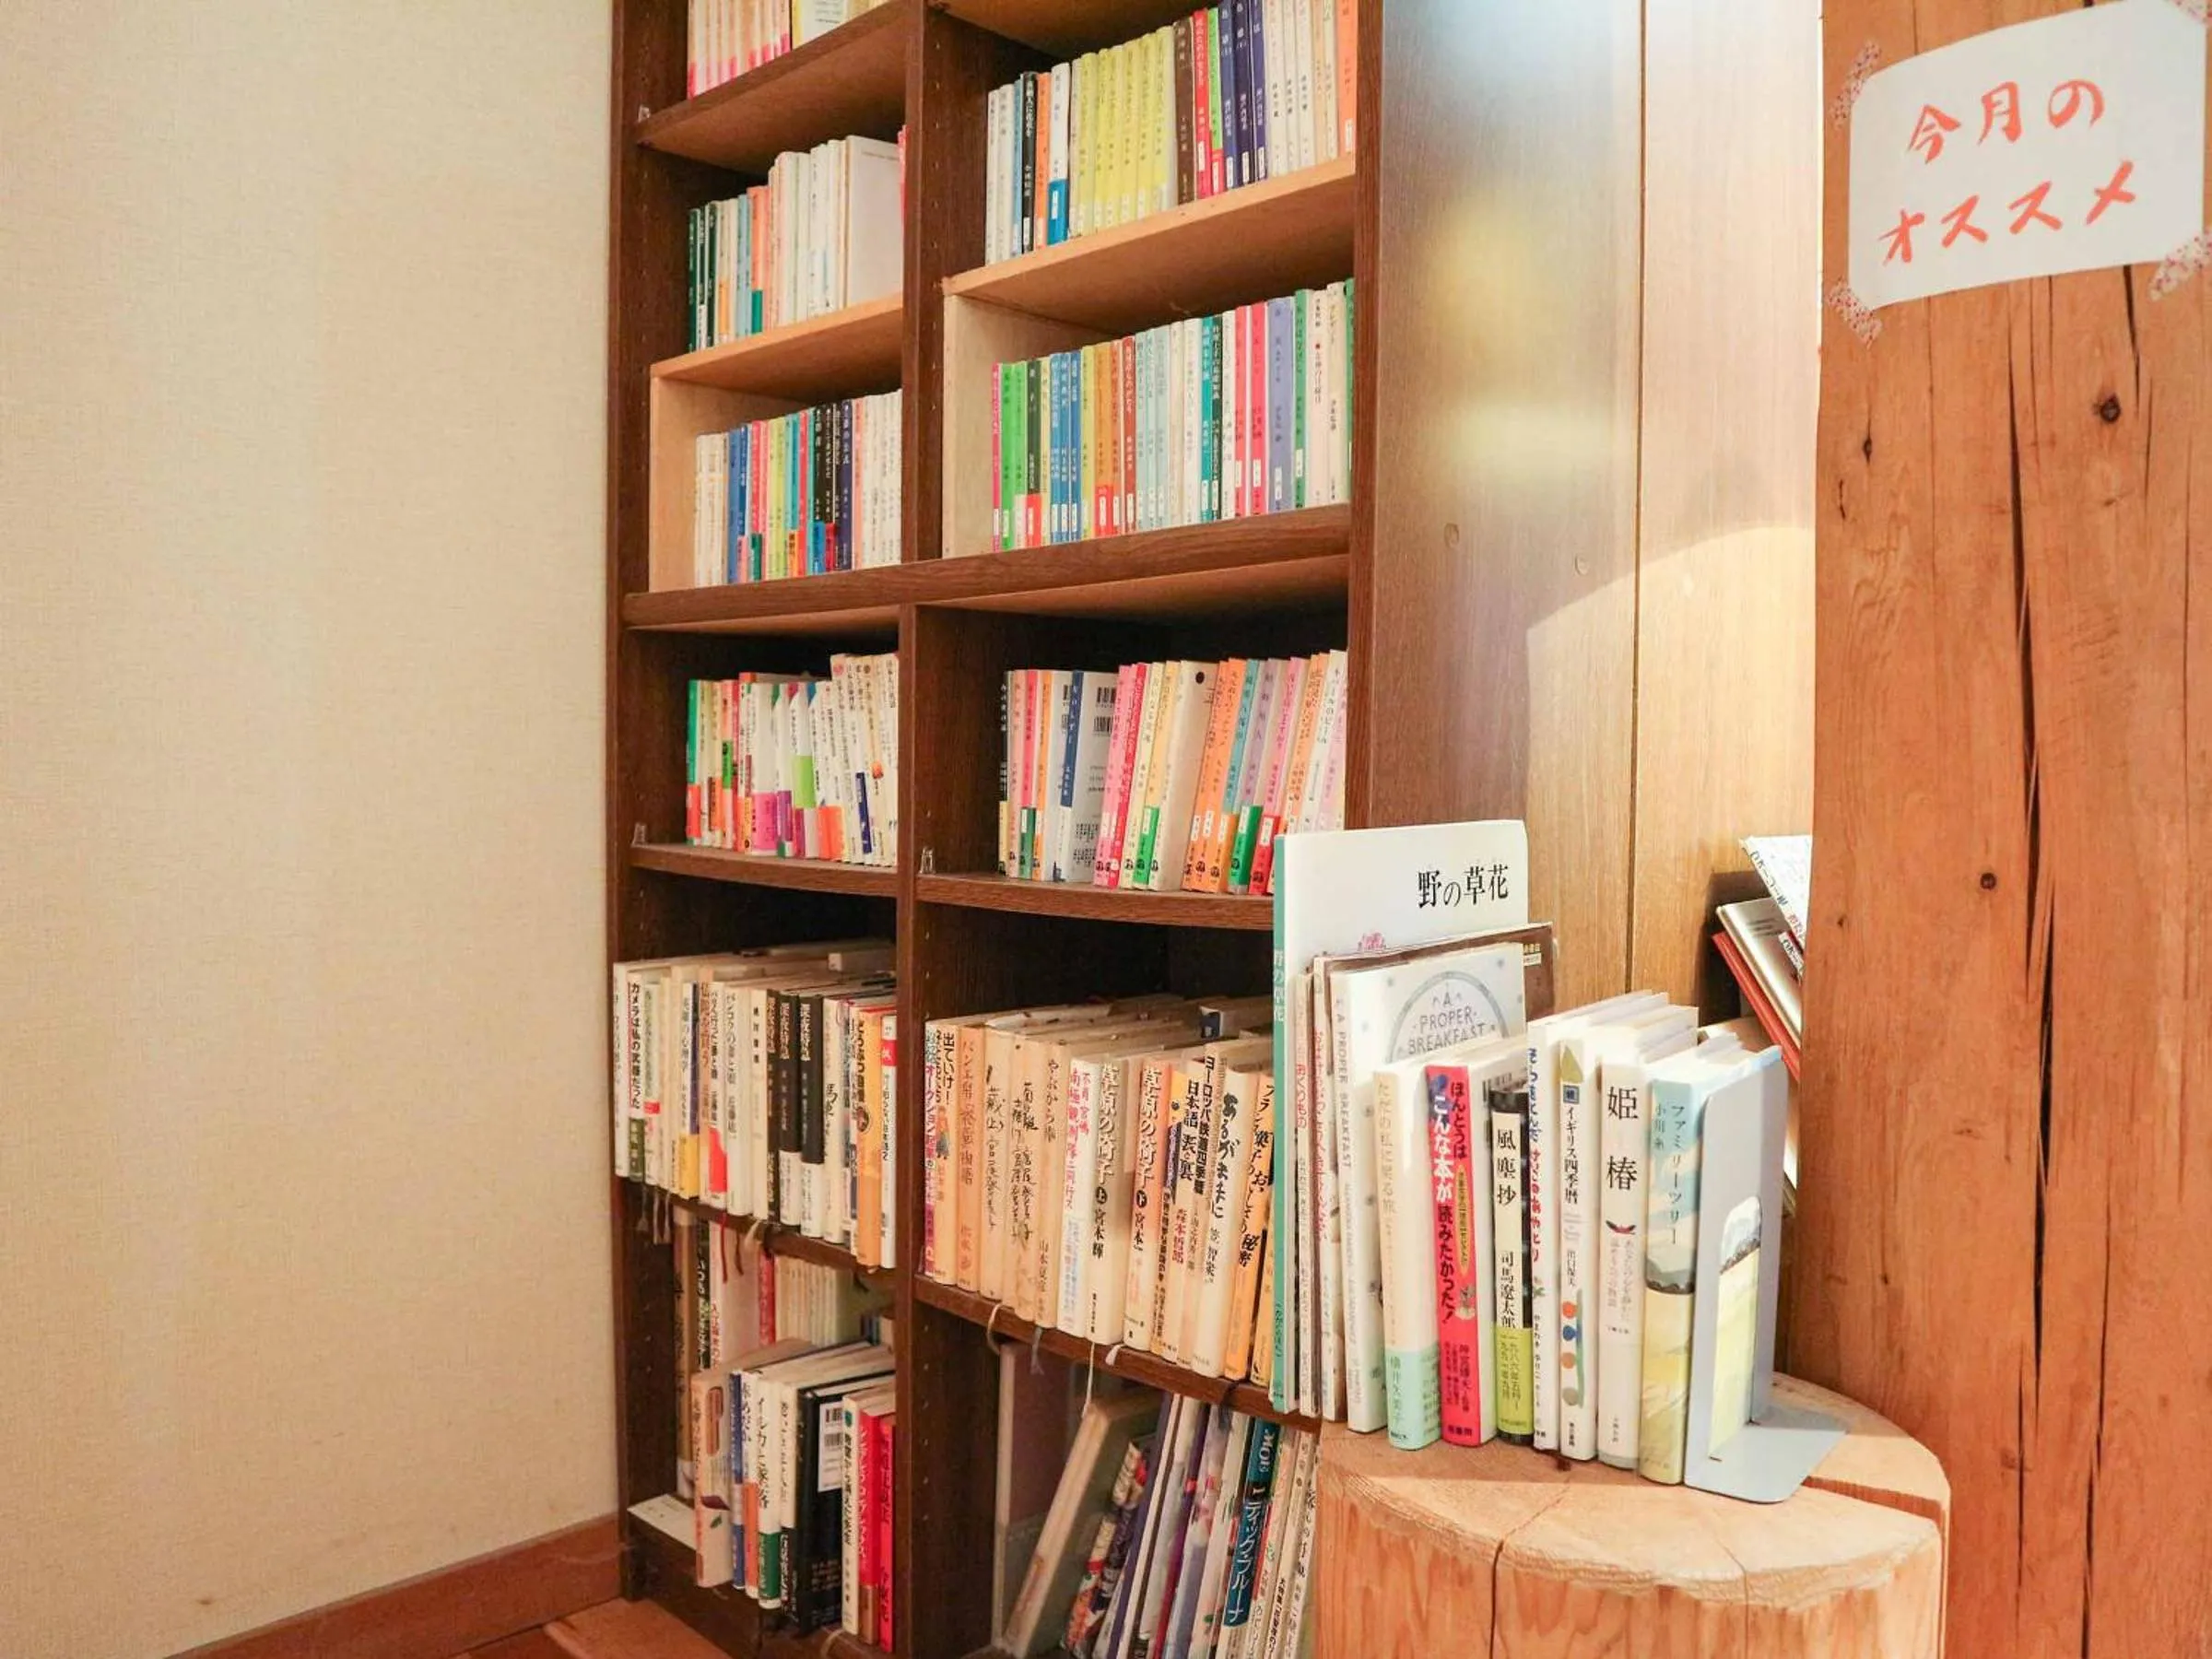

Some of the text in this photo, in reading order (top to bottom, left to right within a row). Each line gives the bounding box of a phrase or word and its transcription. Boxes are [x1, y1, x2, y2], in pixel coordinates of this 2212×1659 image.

[1908, 79, 2105, 165] 今月の
[1877, 159, 2136, 266] オススメ
[1417, 864, 1509, 908] 野の草花
[1408, 1022, 1485, 1055] BREAKFAST
[1419, 1006, 1474, 1033] PROPER
[1183, 1078, 1199, 1129] 日本語
[1450, 1081, 1468, 1160] ほんとうは
[1606, 1086, 1639, 1191] 姫椿
[1497, 1128, 1517, 1206] 風塵抄
[1564, 1106, 1579, 1206] イギリス四季暦
[1668, 1105, 1686, 1244] ファミリーツリー
[1133, 1212, 1146, 1252] 宮本
[1500, 1251, 1516, 1329] 司馬遼太郎
